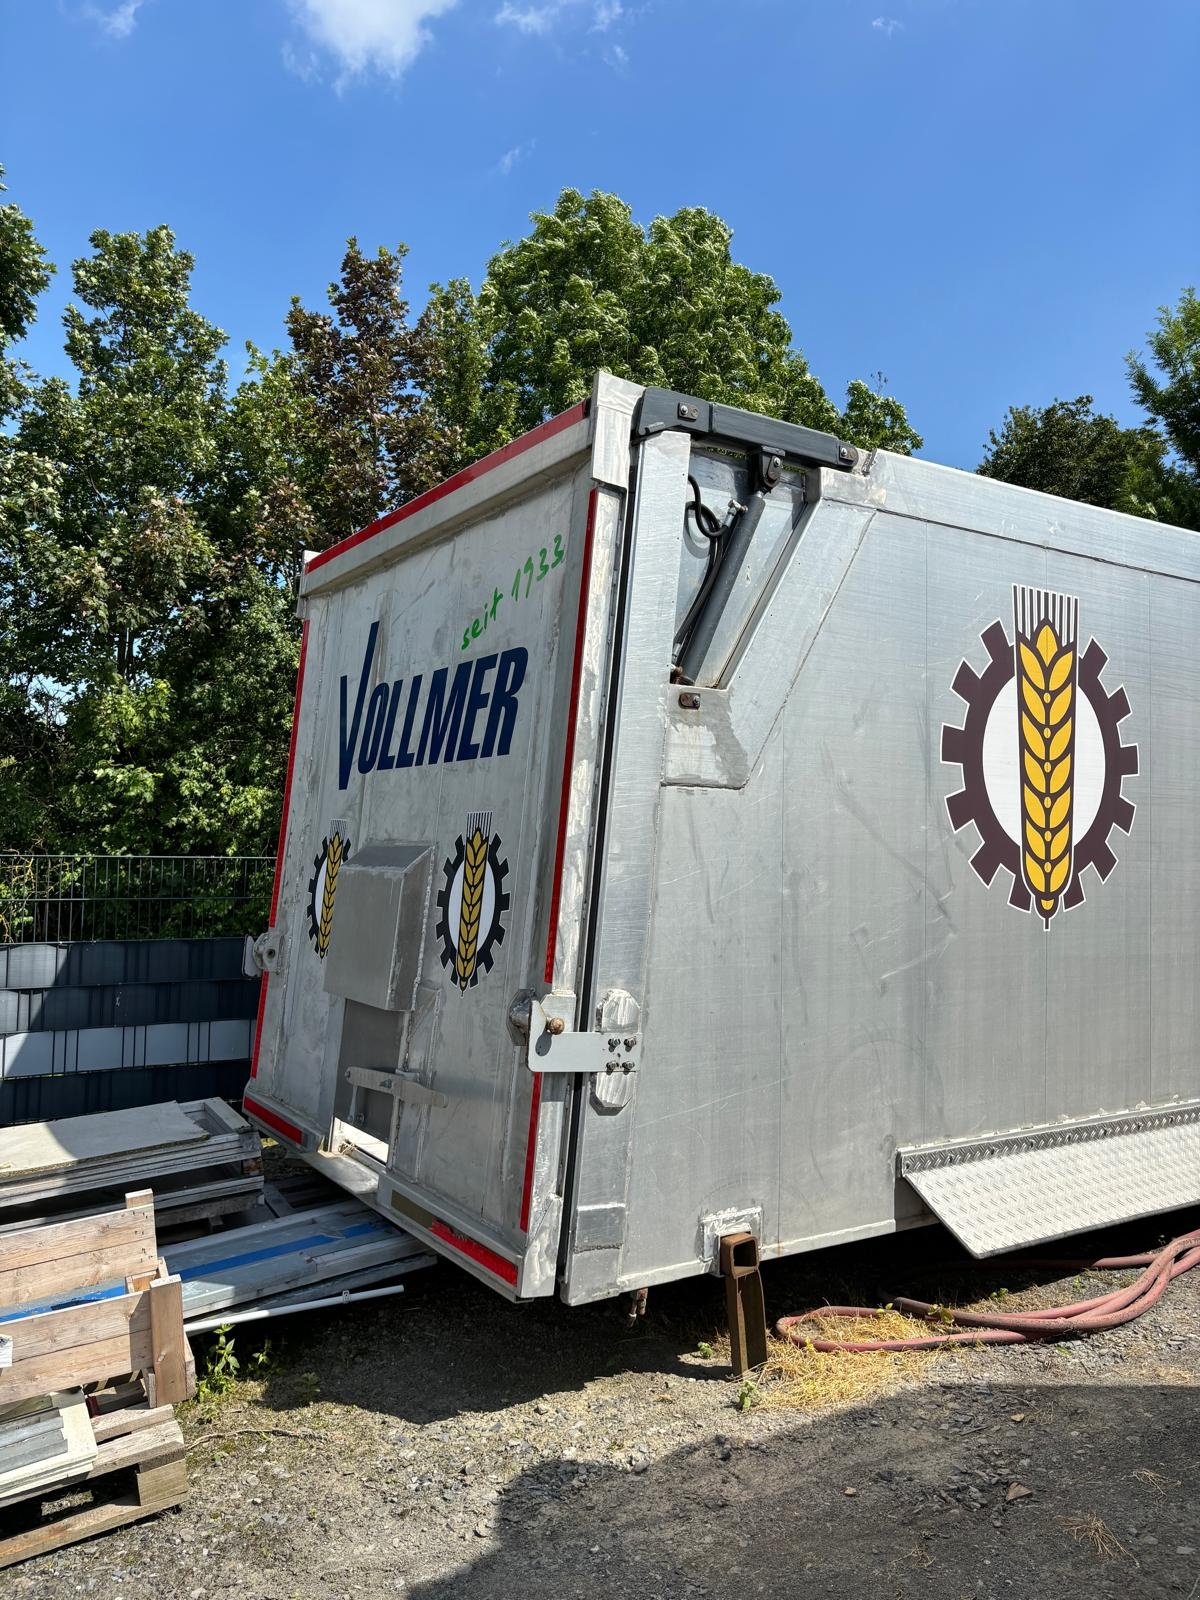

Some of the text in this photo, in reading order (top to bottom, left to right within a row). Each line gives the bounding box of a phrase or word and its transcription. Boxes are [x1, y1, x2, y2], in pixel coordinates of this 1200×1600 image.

[461, 534, 565, 651] seit 1933
[338, 620, 529, 791] VOLLMER
